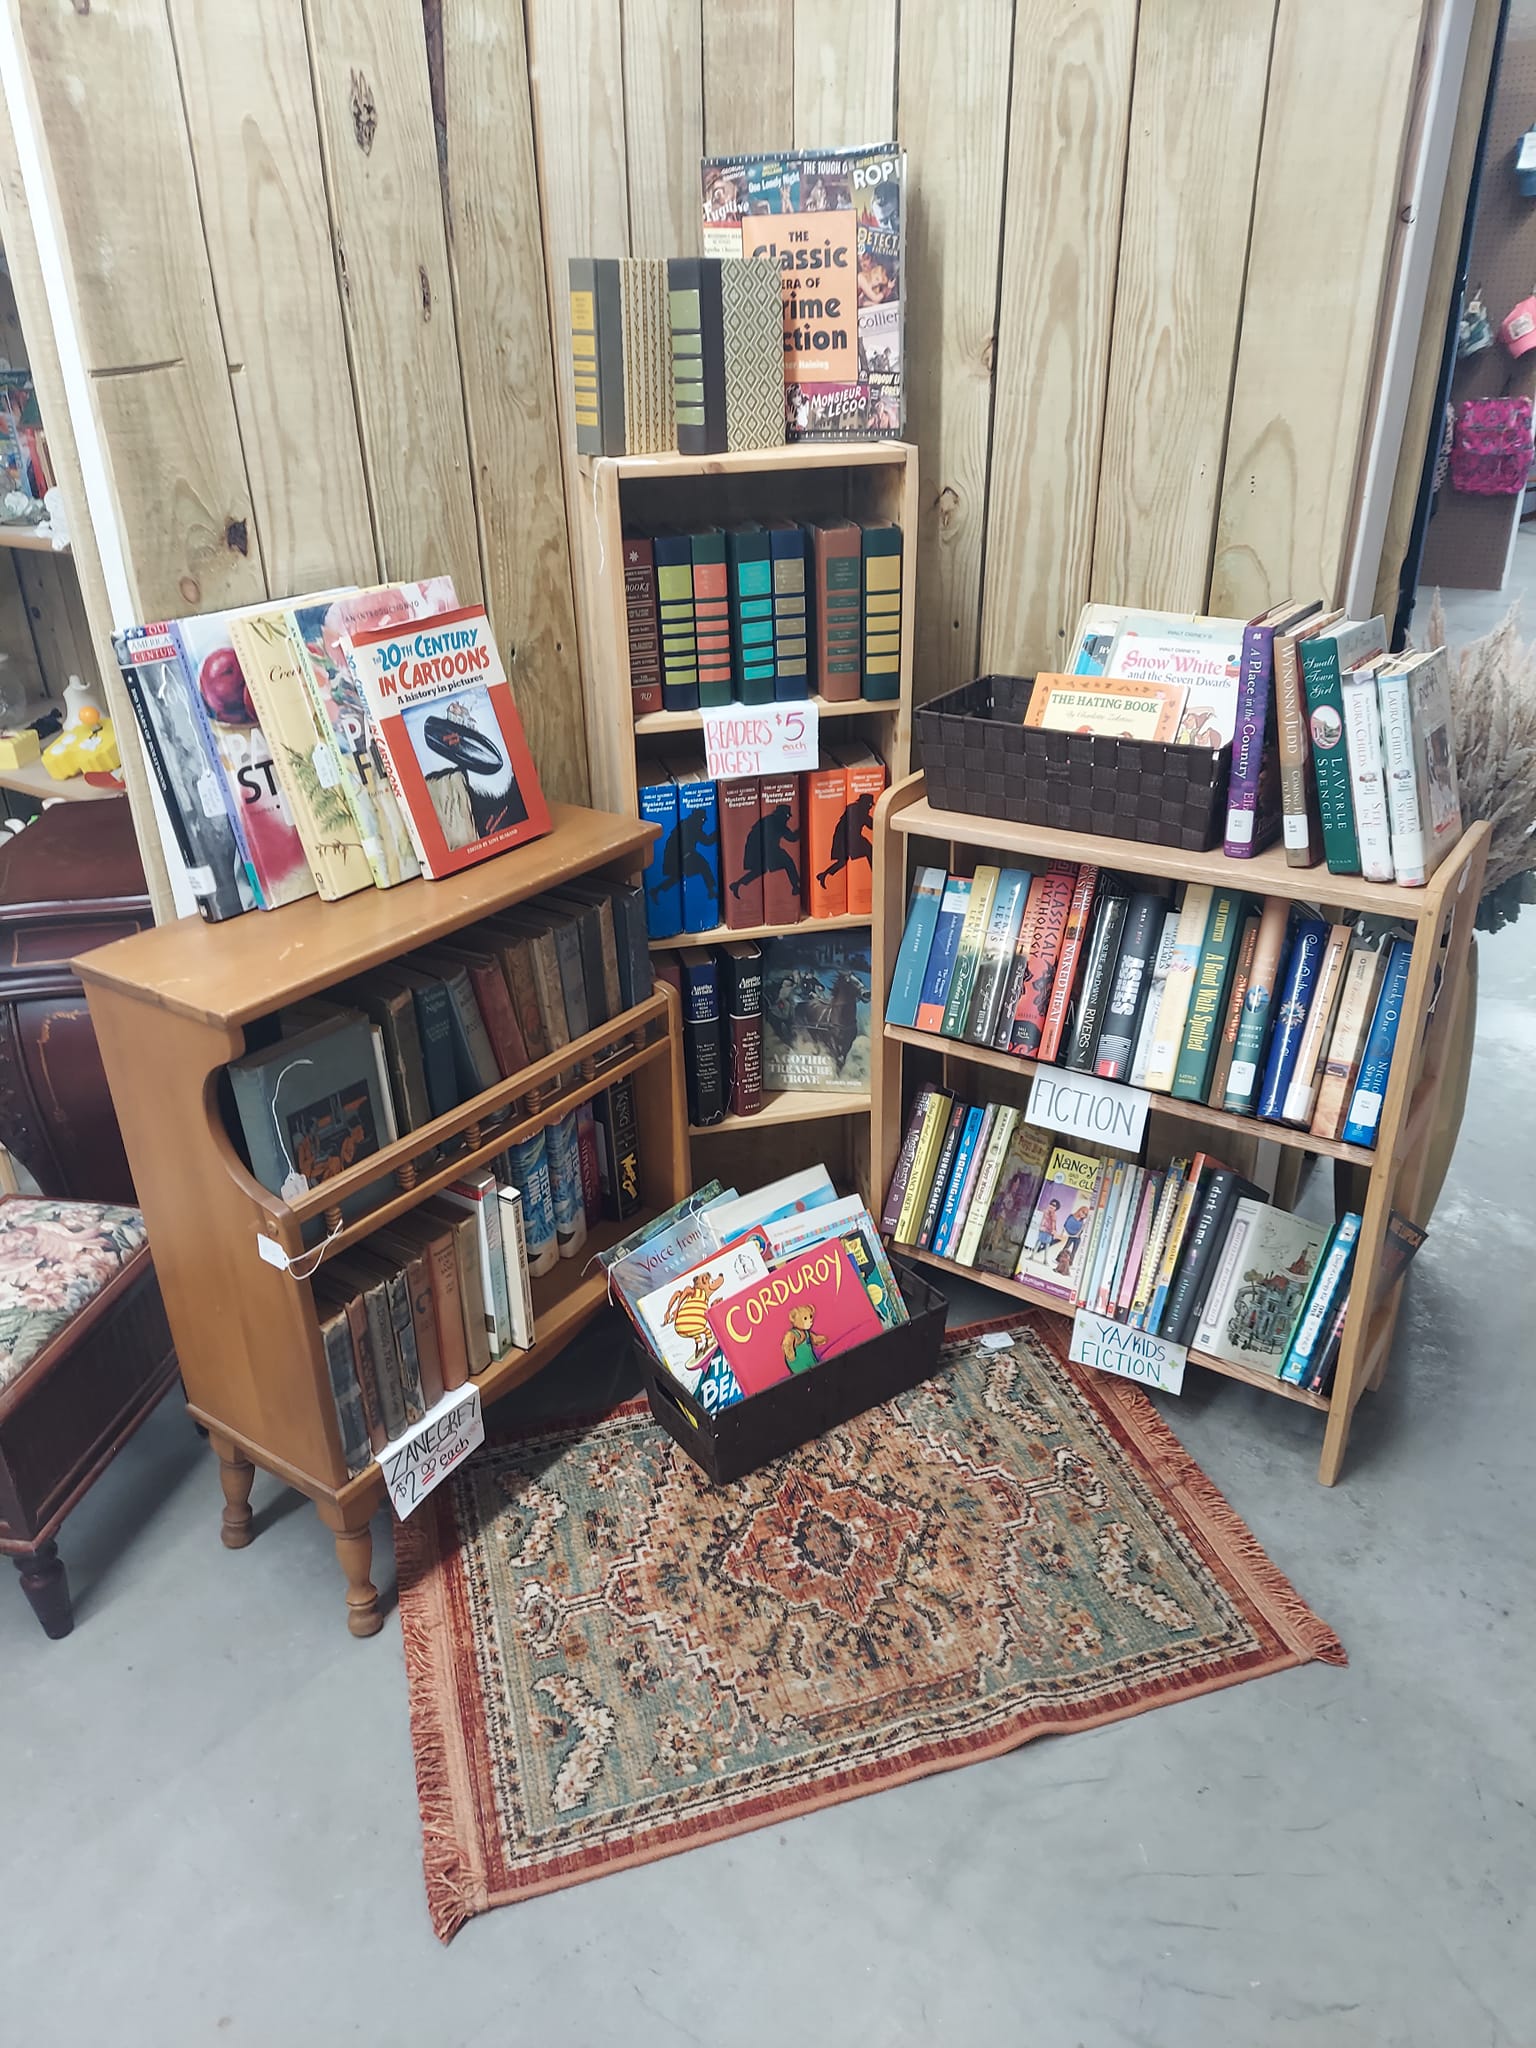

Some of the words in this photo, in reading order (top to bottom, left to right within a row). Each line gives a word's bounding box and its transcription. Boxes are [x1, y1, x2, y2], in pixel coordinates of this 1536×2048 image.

[761, 176, 782, 191] Lonely
[803, 162, 817, 174] THE
[705, 199, 749, 224] Fugitive
[788, 231, 809, 242] THE
[752, 238, 848, 271] Classic
[805, 277, 821, 289] OF
[782, 291, 841, 320] rime
[782, 323, 848, 352] ction
[811, 386, 862, 410] MONSIEUR
[828, 398, 867, 418] LECOQ
[357, 602, 408, 622] INTRODUCTION
[377, 641, 413, 672] 20TH
[414, 629, 478, 657] CENTURY
[1121, 650, 1170, 671] Snow
[1171, 653, 1222, 676] White
[1250, 648, 1261, 657] A
[1303, 655, 1335, 670] Small
[377, 675, 397, 698] IN
[398, 645, 491, 691] CARTOONS
[1128, 670, 1145, 681] and
[1146, 671, 1161, 682] the
[1162, 673, 1193, 685] Seven
[1195, 675, 1231, 689] Dwarfs
[1247, 660, 1262, 701] Place
[1281, 644, 1297, 717] WYNONNA
[1304, 671, 1334, 684] Town
[397, 696, 404, 705] A
[404, 687, 437, 705] history
[437, 683, 447, 694] in
[447, 673, 484, 692] pictures
[1052, 693, 1075, 705] THE
[1077, 696, 1122, 710] HATING
[1125, 701, 1158, 714] BOOK
[1309, 684, 1332, 698] Girl
[1243, 709, 1256, 722] the
[1246, 700, 1256, 710] in
[1352, 693, 1363, 727] LAURA
[1388, 690, 1398, 723] LAURA
[706, 719, 773, 750] READERS
[775, 712, 805, 742] $5
[1284, 718, 1297, 754] JUDD
[136, 703, 147, 727] YEARS
[145, 727, 151, 740] OF
[148, 740, 168, 791] HOLLYWOOD
[782, 741, 807, 752] each
[1238, 723, 1256, 780] Country
[1355, 729, 1367, 769] CHILDS
[1390, 724, 1402, 766] CHILDS
[374, 735, 404, 799] CARTOONS
[707, 750, 762, 778] DIGEST
[1282, 781, 1290, 792] TO
[1291, 770, 1300, 805] COMING
[1317, 759, 1333, 830] SPENCER
[1331, 757, 1347, 830] LAVYRLE
[1072, 864, 1088, 910] CASTLE
[1081, 866, 1097, 912] RICHARD
[1030, 879, 1054, 959] MYTHOLOGY
[1040, 881, 1067, 959] CLASSICAL
[1057, 942, 1075, 990] NAKED
[1098, 944, 1109, 963] SURE
[1159, 933, 1171, 970] HOLMES
[1206, 952, 1225, 962] A
[1398, 950, 1413, 971] The
[1111, 955, 1145, 1016] ASHES
[1200, 963, 1220, 987] Good
[1384, 973, 1405, 1007] Lucky
[1049, 989, 1066, 1025] HEAT
[1090, 980, 1101, 1005] DAWN
[1194, 988, 1218, 1012] Walk
[1079, 1008, 1095, 1049] RIVERS
[1186, 1013, 1213, 1052] Spoiled
[1379, 1009, 1397, 1033] One
[781, 1054, 831, 1065] GOTHIC
[1237, 1041, 1260, 1049] WALLER
[769, 1064, 832, 1075] TREASURE
[781, 1074, 820, 1084] TROVE
[1031, 1078, 1136, 1137] FICTION
[908, 1170, 918, 1192] NANCY
[937, 1152, 952, 1186] HUNGER
[1053, 1153, 1099, 1180] Nancy
[527, 1171, 541, 1207] KING
[539, 1163, 554, 1222] STEPHEN
[946, 1152, 968, 1215] MOCKINGJAY
[1210, 1185, 1222, 1209] dark
[904, 1192, 915, 1212] DREW
[928, 1185, 941, 1215] GAMES
[513, 1206, 521, 1224] FROM
[518, 1246, 524, 1255] TO
[1194, 1212, 1214, 1246] flame
[637, 1246, 674, 1273] Voice
[678, 1229, 702, 1251] from
[725, 1249, 844, 1344] CORDUROY
[1096, 1321, 1166, 1361] YA/KIDS
[1081, 1341, 1161, 1382] FICTION
[386, 1424, 438, 1486] ZANE
[437, 1396, 476, 1441] GREY
[439, 1437, 469, 1467] each
